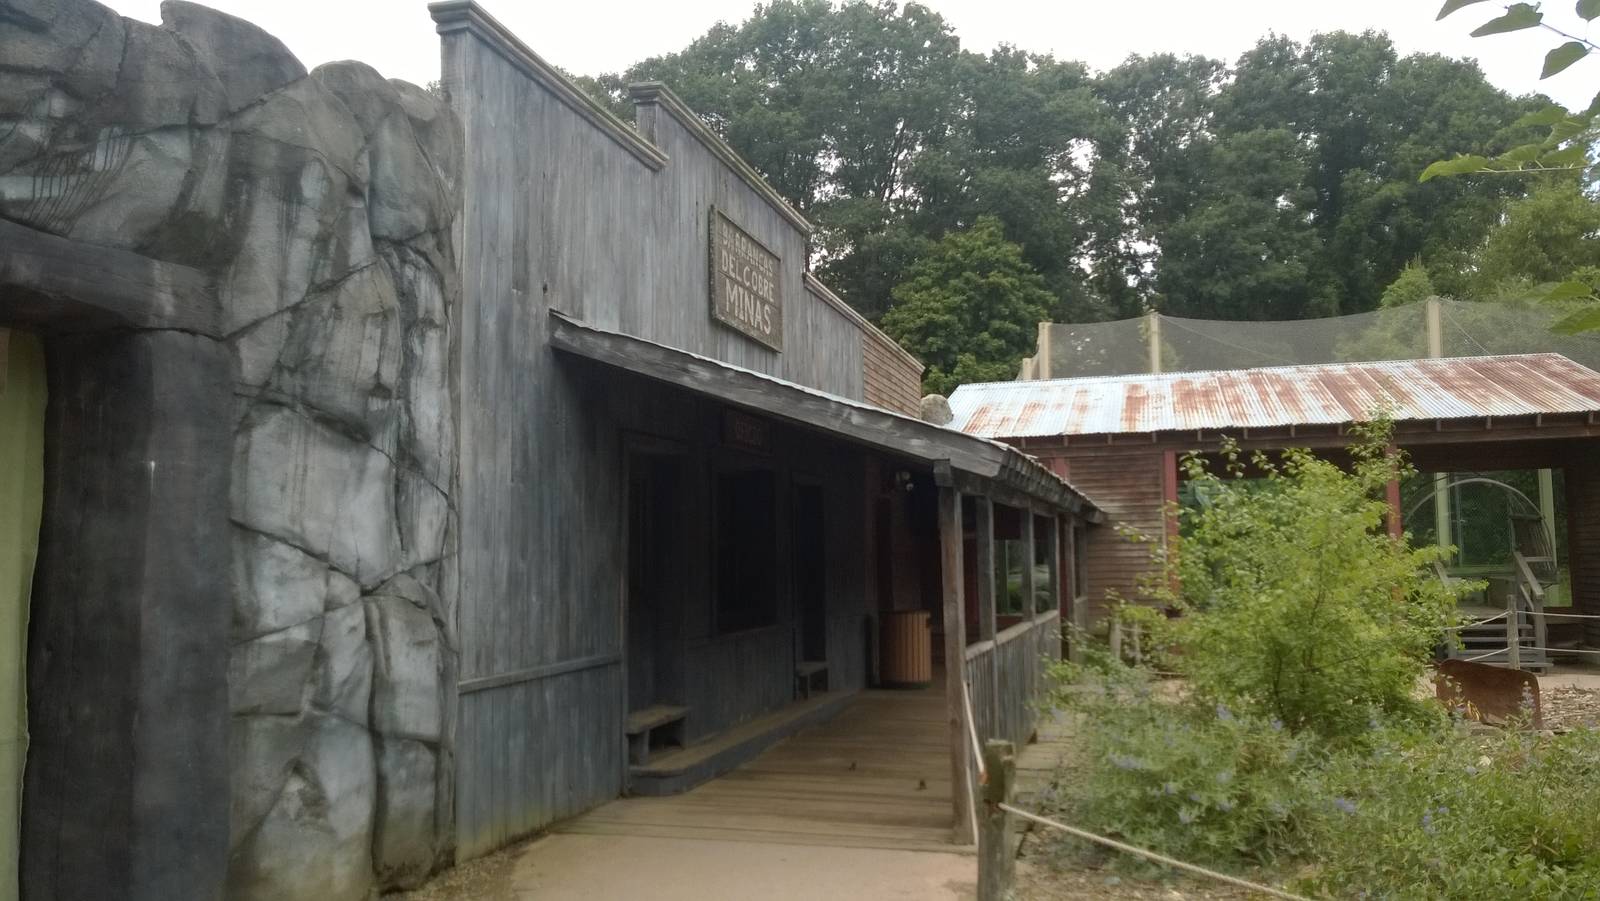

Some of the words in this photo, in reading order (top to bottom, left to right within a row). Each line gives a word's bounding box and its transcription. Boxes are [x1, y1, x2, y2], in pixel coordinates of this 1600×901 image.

[721, 249, 742, 282] DEL
[743, 266, 775, 303] COBRE
[725, 278, 772, 335] MINAS
